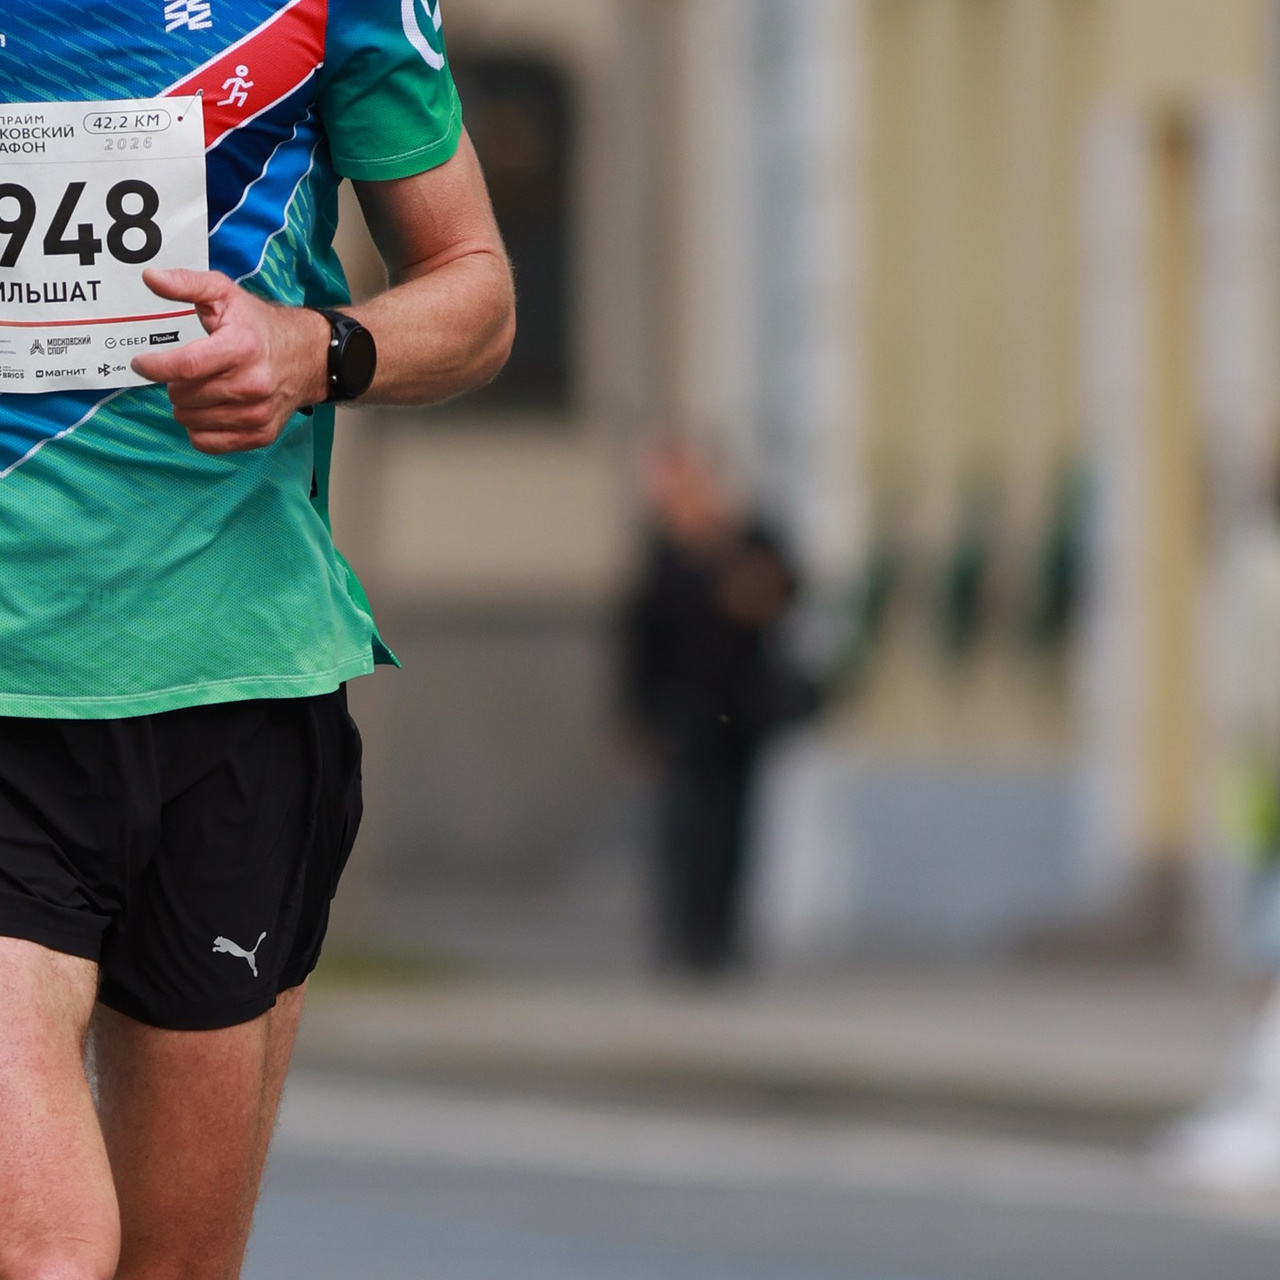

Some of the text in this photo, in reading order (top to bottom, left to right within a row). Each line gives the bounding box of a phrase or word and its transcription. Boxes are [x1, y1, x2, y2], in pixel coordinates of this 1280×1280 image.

[92, 113, 160, 131] 42,2 КМ
[104, 136, 154, 151] 2026
[47, 335, 91, 346] МОСКОВСКИЙ
[120, 336, 147, 346] СБЕР
[47, 346, 68, 355] СПОРТ
